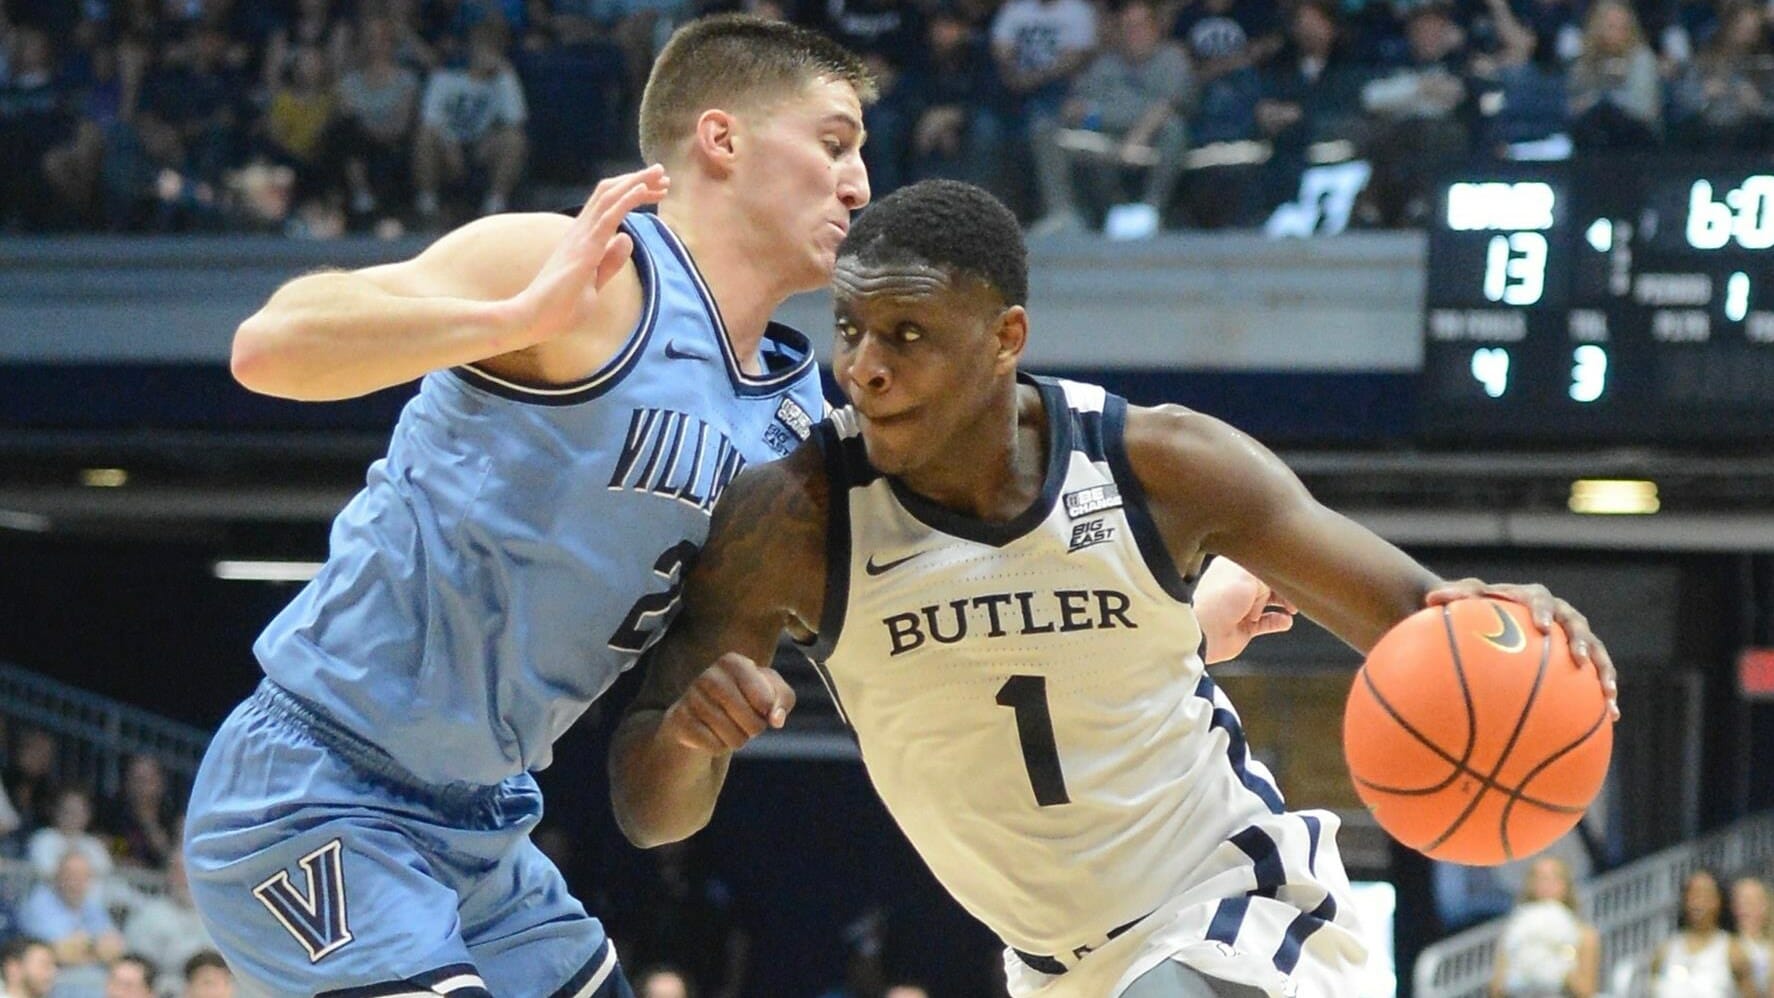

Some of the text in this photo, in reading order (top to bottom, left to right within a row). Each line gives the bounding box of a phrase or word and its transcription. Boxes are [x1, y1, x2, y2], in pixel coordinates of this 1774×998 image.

[1484, 232, 1547, 305] 13
[1725, 271, 1750, 322] 1
[1570, 345, 1607, 402] 3
[1069, 527, 1115, 548] EAST
[1073, 518, 1104, 536] BIG
[882, 590, 1138, 656] BUTLER
[996, 675, 1072, 807] 1
[251, 837, 354, 964] V
